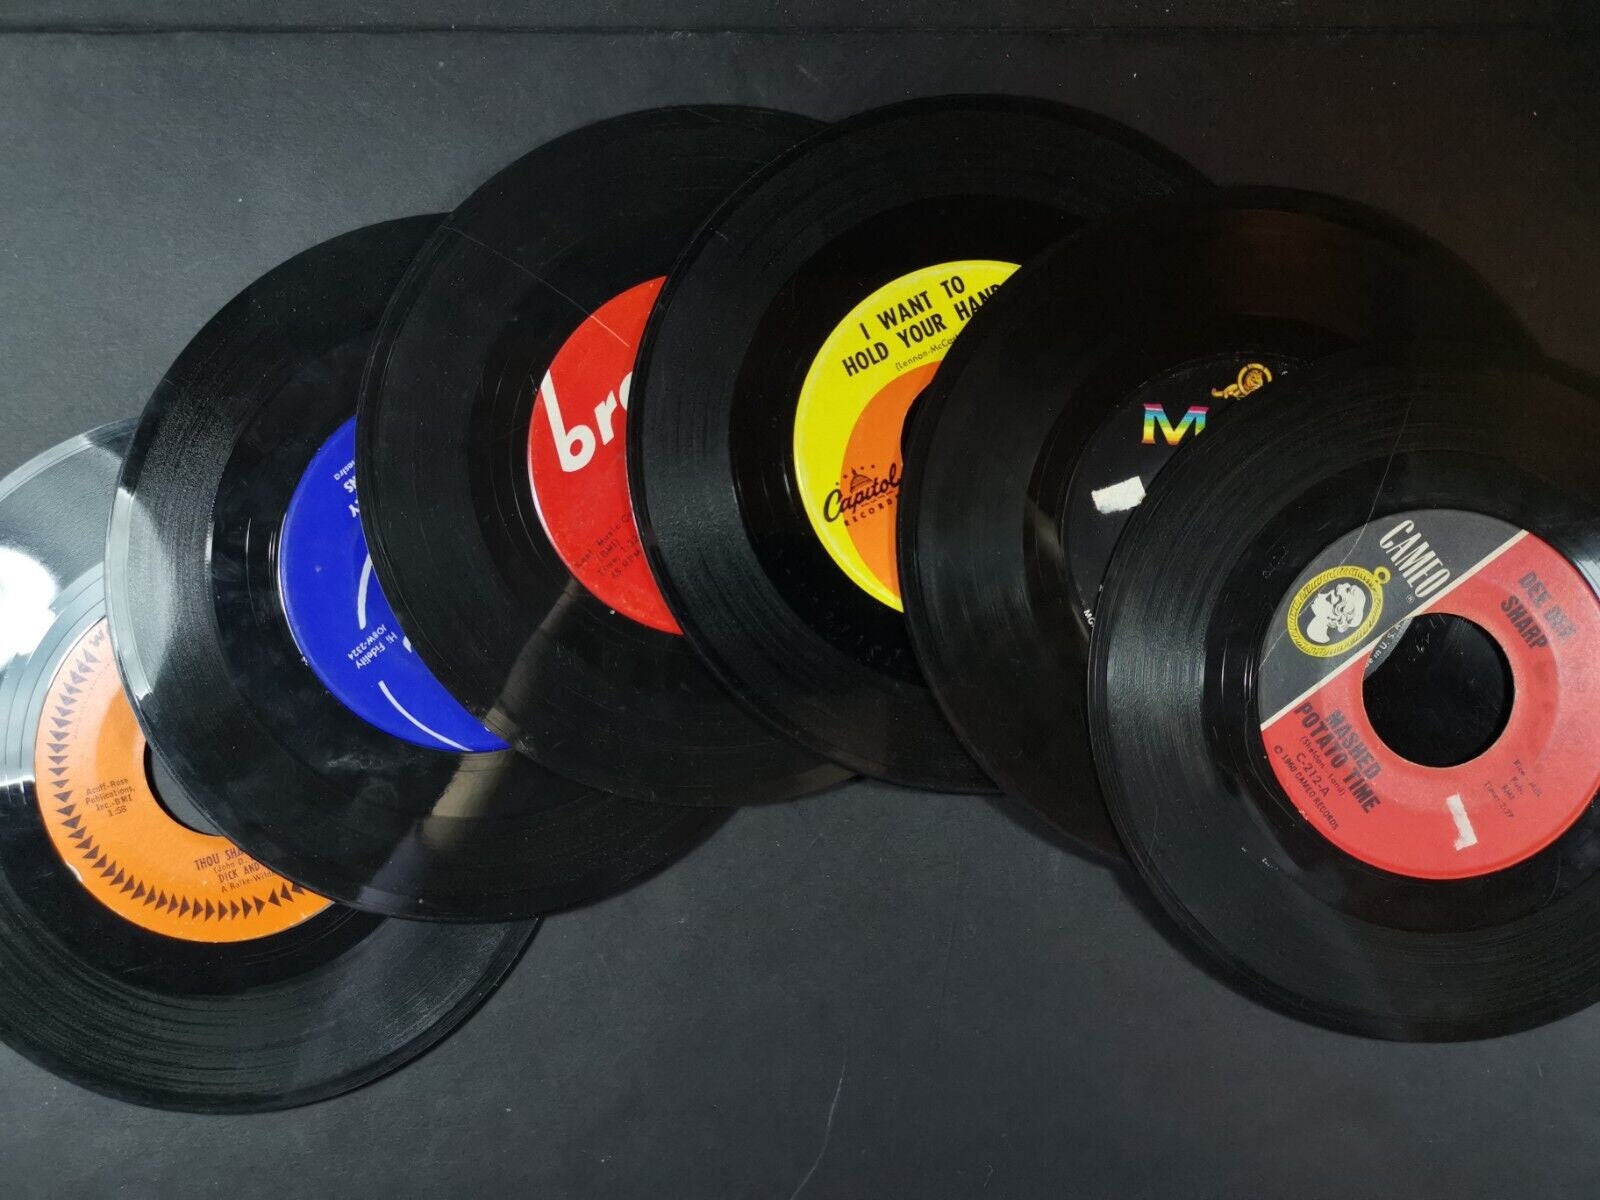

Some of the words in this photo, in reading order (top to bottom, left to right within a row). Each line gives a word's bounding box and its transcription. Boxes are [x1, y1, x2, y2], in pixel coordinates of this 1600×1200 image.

[859, 322, 870, 340] I
[876, 290, 933, 331] WANT
[940, 275, 965, 299] TO
[841, 341, 889, 377] HOLD
[896, 313, 948, 349] YOUR
[823, 462, 902, 523] Capitol
[1379, 519, 1451, 598] CAMEO
[385, 631, 398, 644] Hi
[1501, 594, 1549, 649] SHARP
[355, 641, 386, 669] Fidelity
[1294, 701, 1348, 769] POTATO
[1343, 767, 1381, 814] TIME
[1326, 709, 1381, 779] MASHED
[1295, 771, 1316, 798] CAMEO
[1313, 798, 1339, 831] RECORDS
[1296, 753, 1330, 797] C-212-A
[194, 853, 220, 871] THOU
[218, 869, 238, 883] DICK
